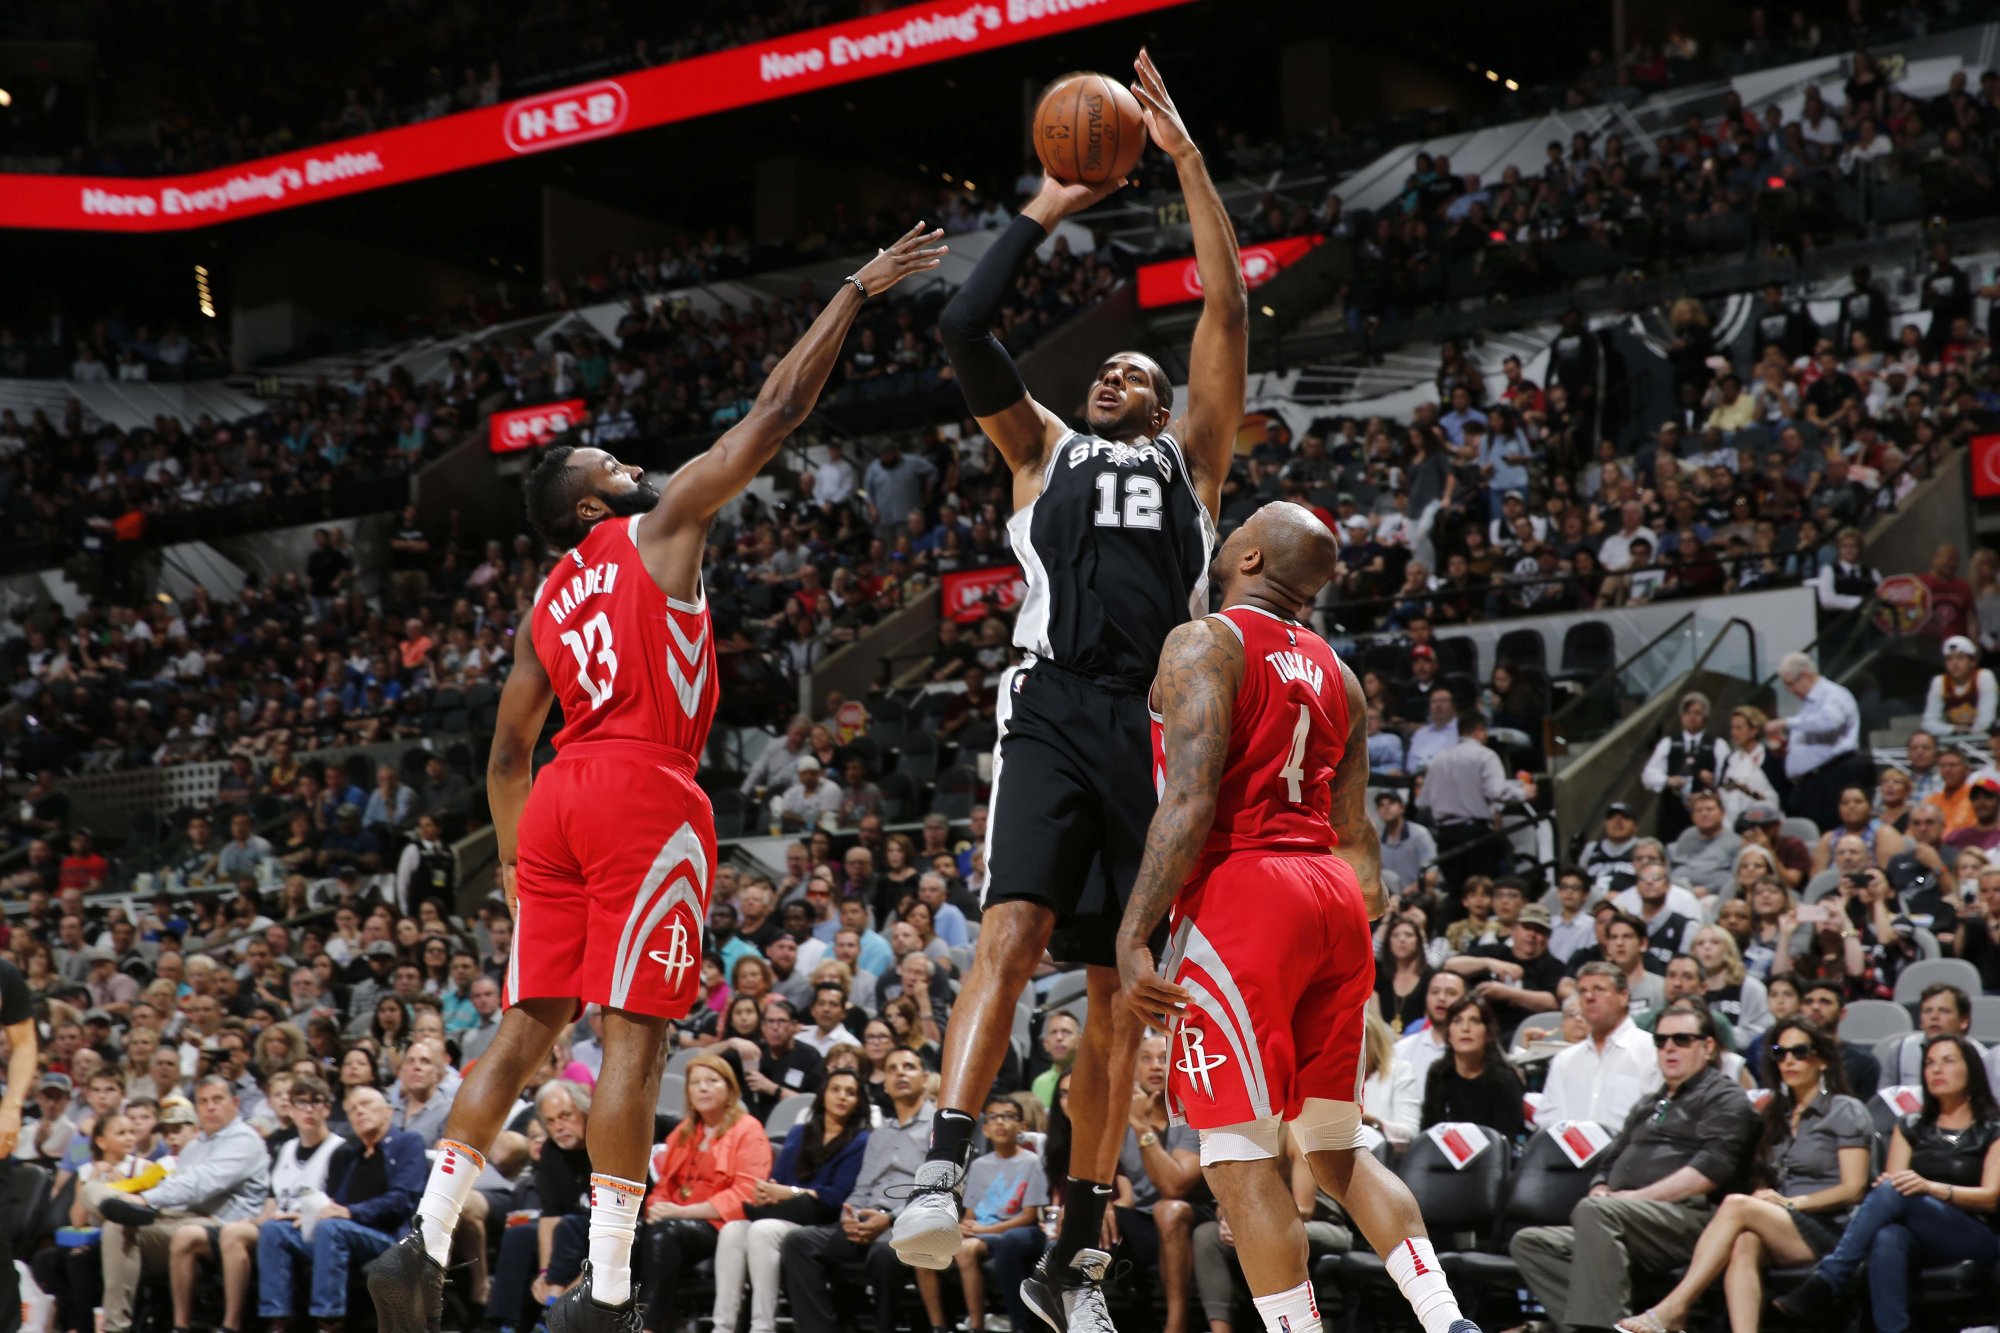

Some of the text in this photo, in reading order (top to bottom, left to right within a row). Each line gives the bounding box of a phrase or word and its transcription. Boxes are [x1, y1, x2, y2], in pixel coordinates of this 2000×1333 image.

[760, 49, 824, 81] Here
[1084, 94, 1104, 171] SPALDING
[1094, 472, 1162, 530] 12
[548, 562, 619, 625] HARDEN
[560, 611, 618, 711] 13
[1265, 650, 1323, 697] TUCKER
[1278, 703, 1311, 803] 4
